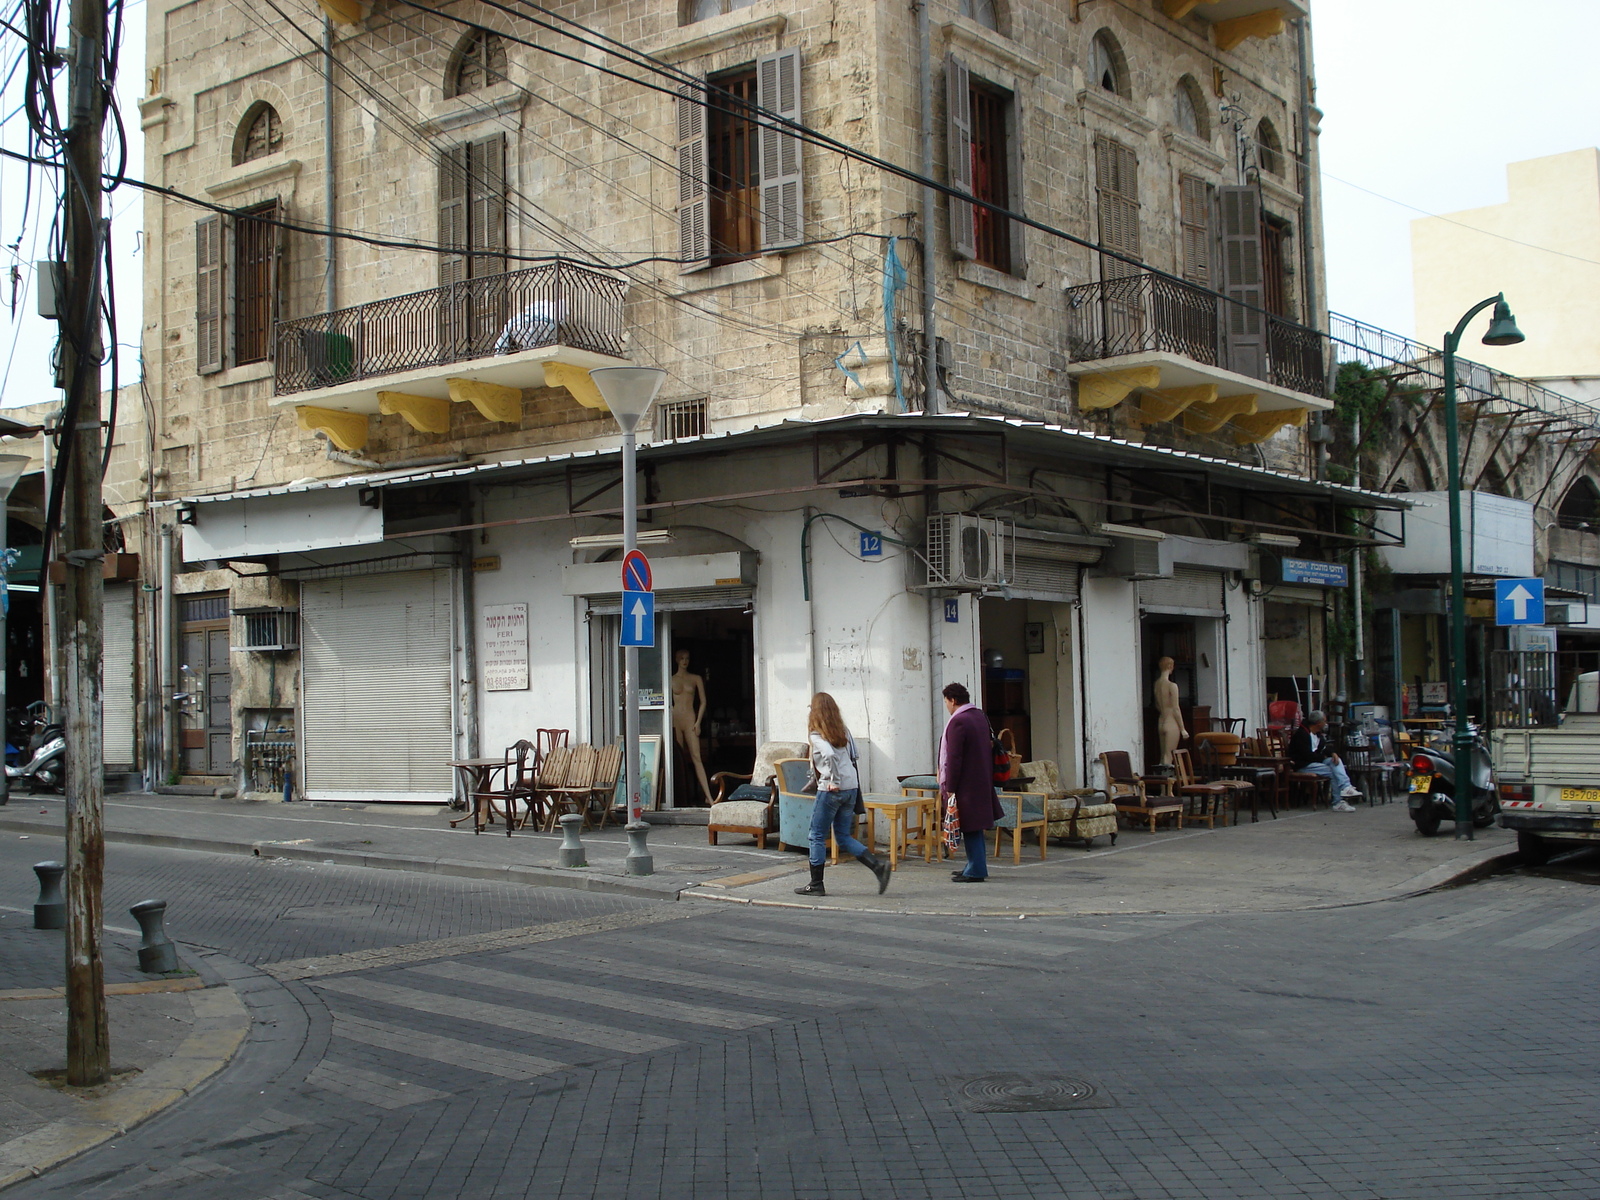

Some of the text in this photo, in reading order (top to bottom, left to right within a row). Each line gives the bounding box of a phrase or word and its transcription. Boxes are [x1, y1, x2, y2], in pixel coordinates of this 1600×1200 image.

[863, 537, 879, 552] 12
[946, 604, 957, 619] 14
[486, 614, 525, 630] החנות הקטנה
[496, 630, 513, 638] FERI
